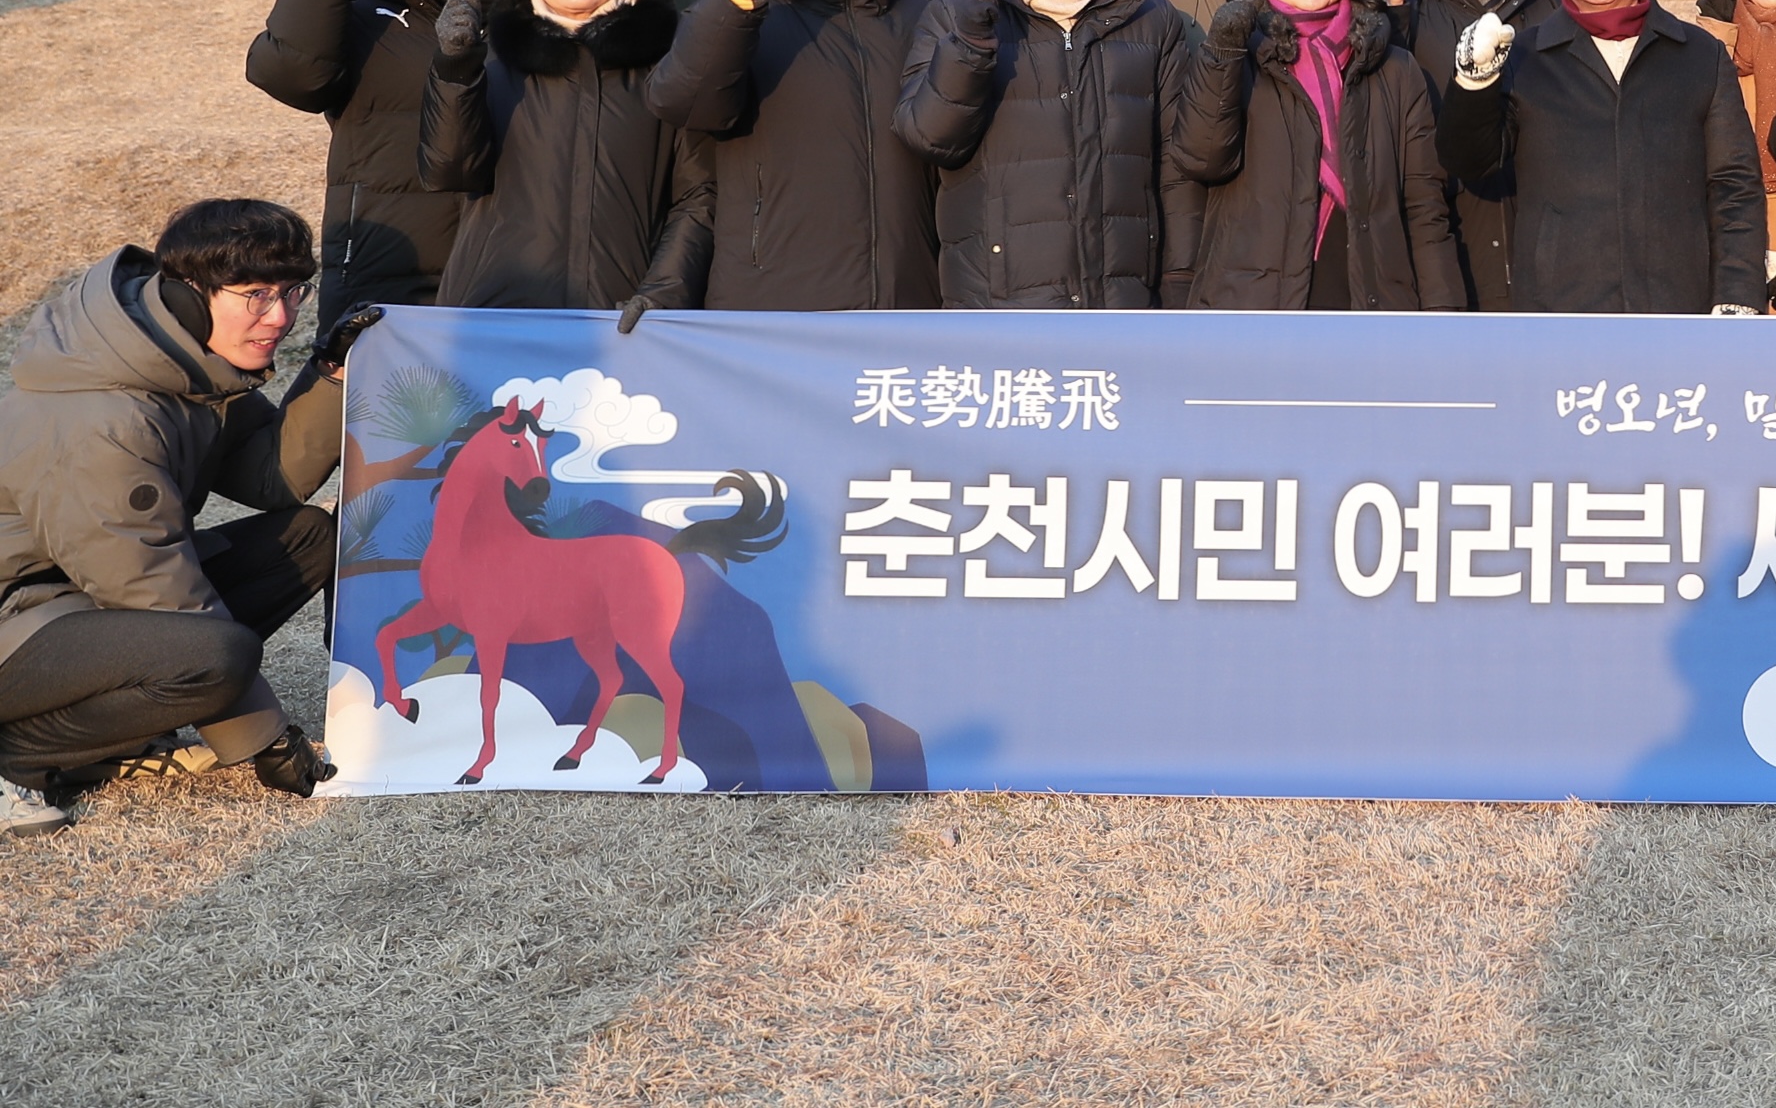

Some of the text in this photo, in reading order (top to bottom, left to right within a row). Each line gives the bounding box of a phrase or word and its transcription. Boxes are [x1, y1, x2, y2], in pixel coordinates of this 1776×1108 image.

[852, 365, 1122, 431] 乘勢騰飛
[1556, 379, 1718, 441] 병오년,
[840, 469, 1298, 601] 춘천시민
[1334, 480, 1705, 604] 여러분!
